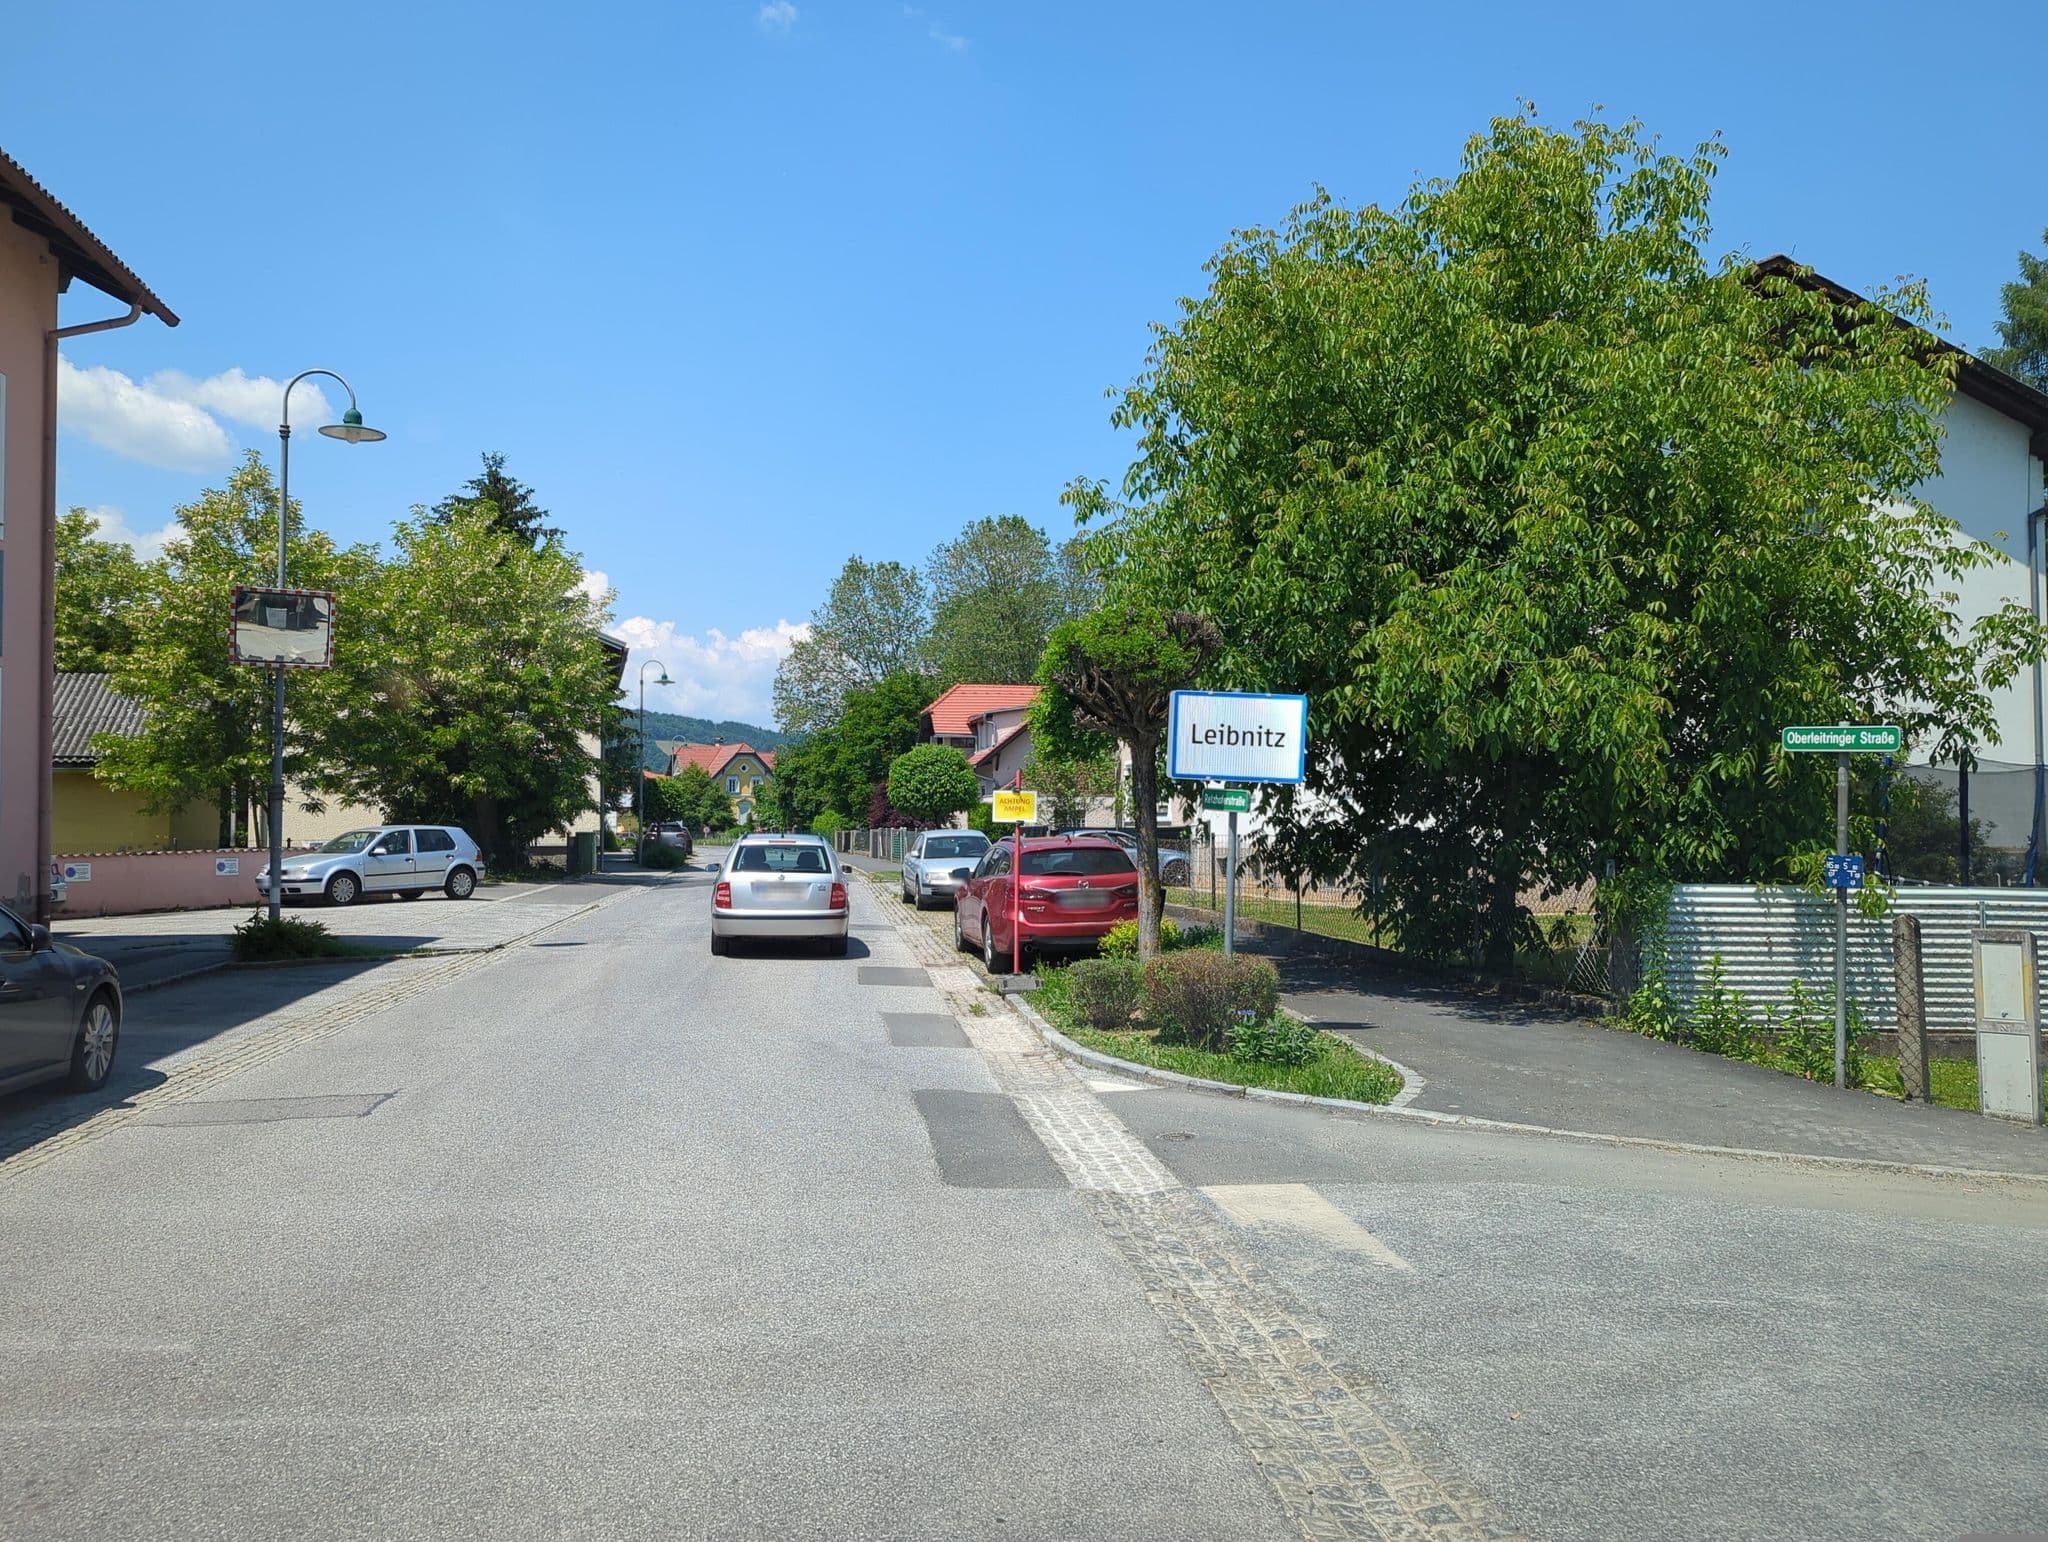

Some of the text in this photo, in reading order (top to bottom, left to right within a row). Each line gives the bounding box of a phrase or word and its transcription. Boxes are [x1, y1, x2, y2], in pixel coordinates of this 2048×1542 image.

[1191, 723, 1286, 748] Leibnitz
[1786, 731, 1895, 747] Oberleitringer Straße
[999, 797, 1031, 805] ACHTUNG
